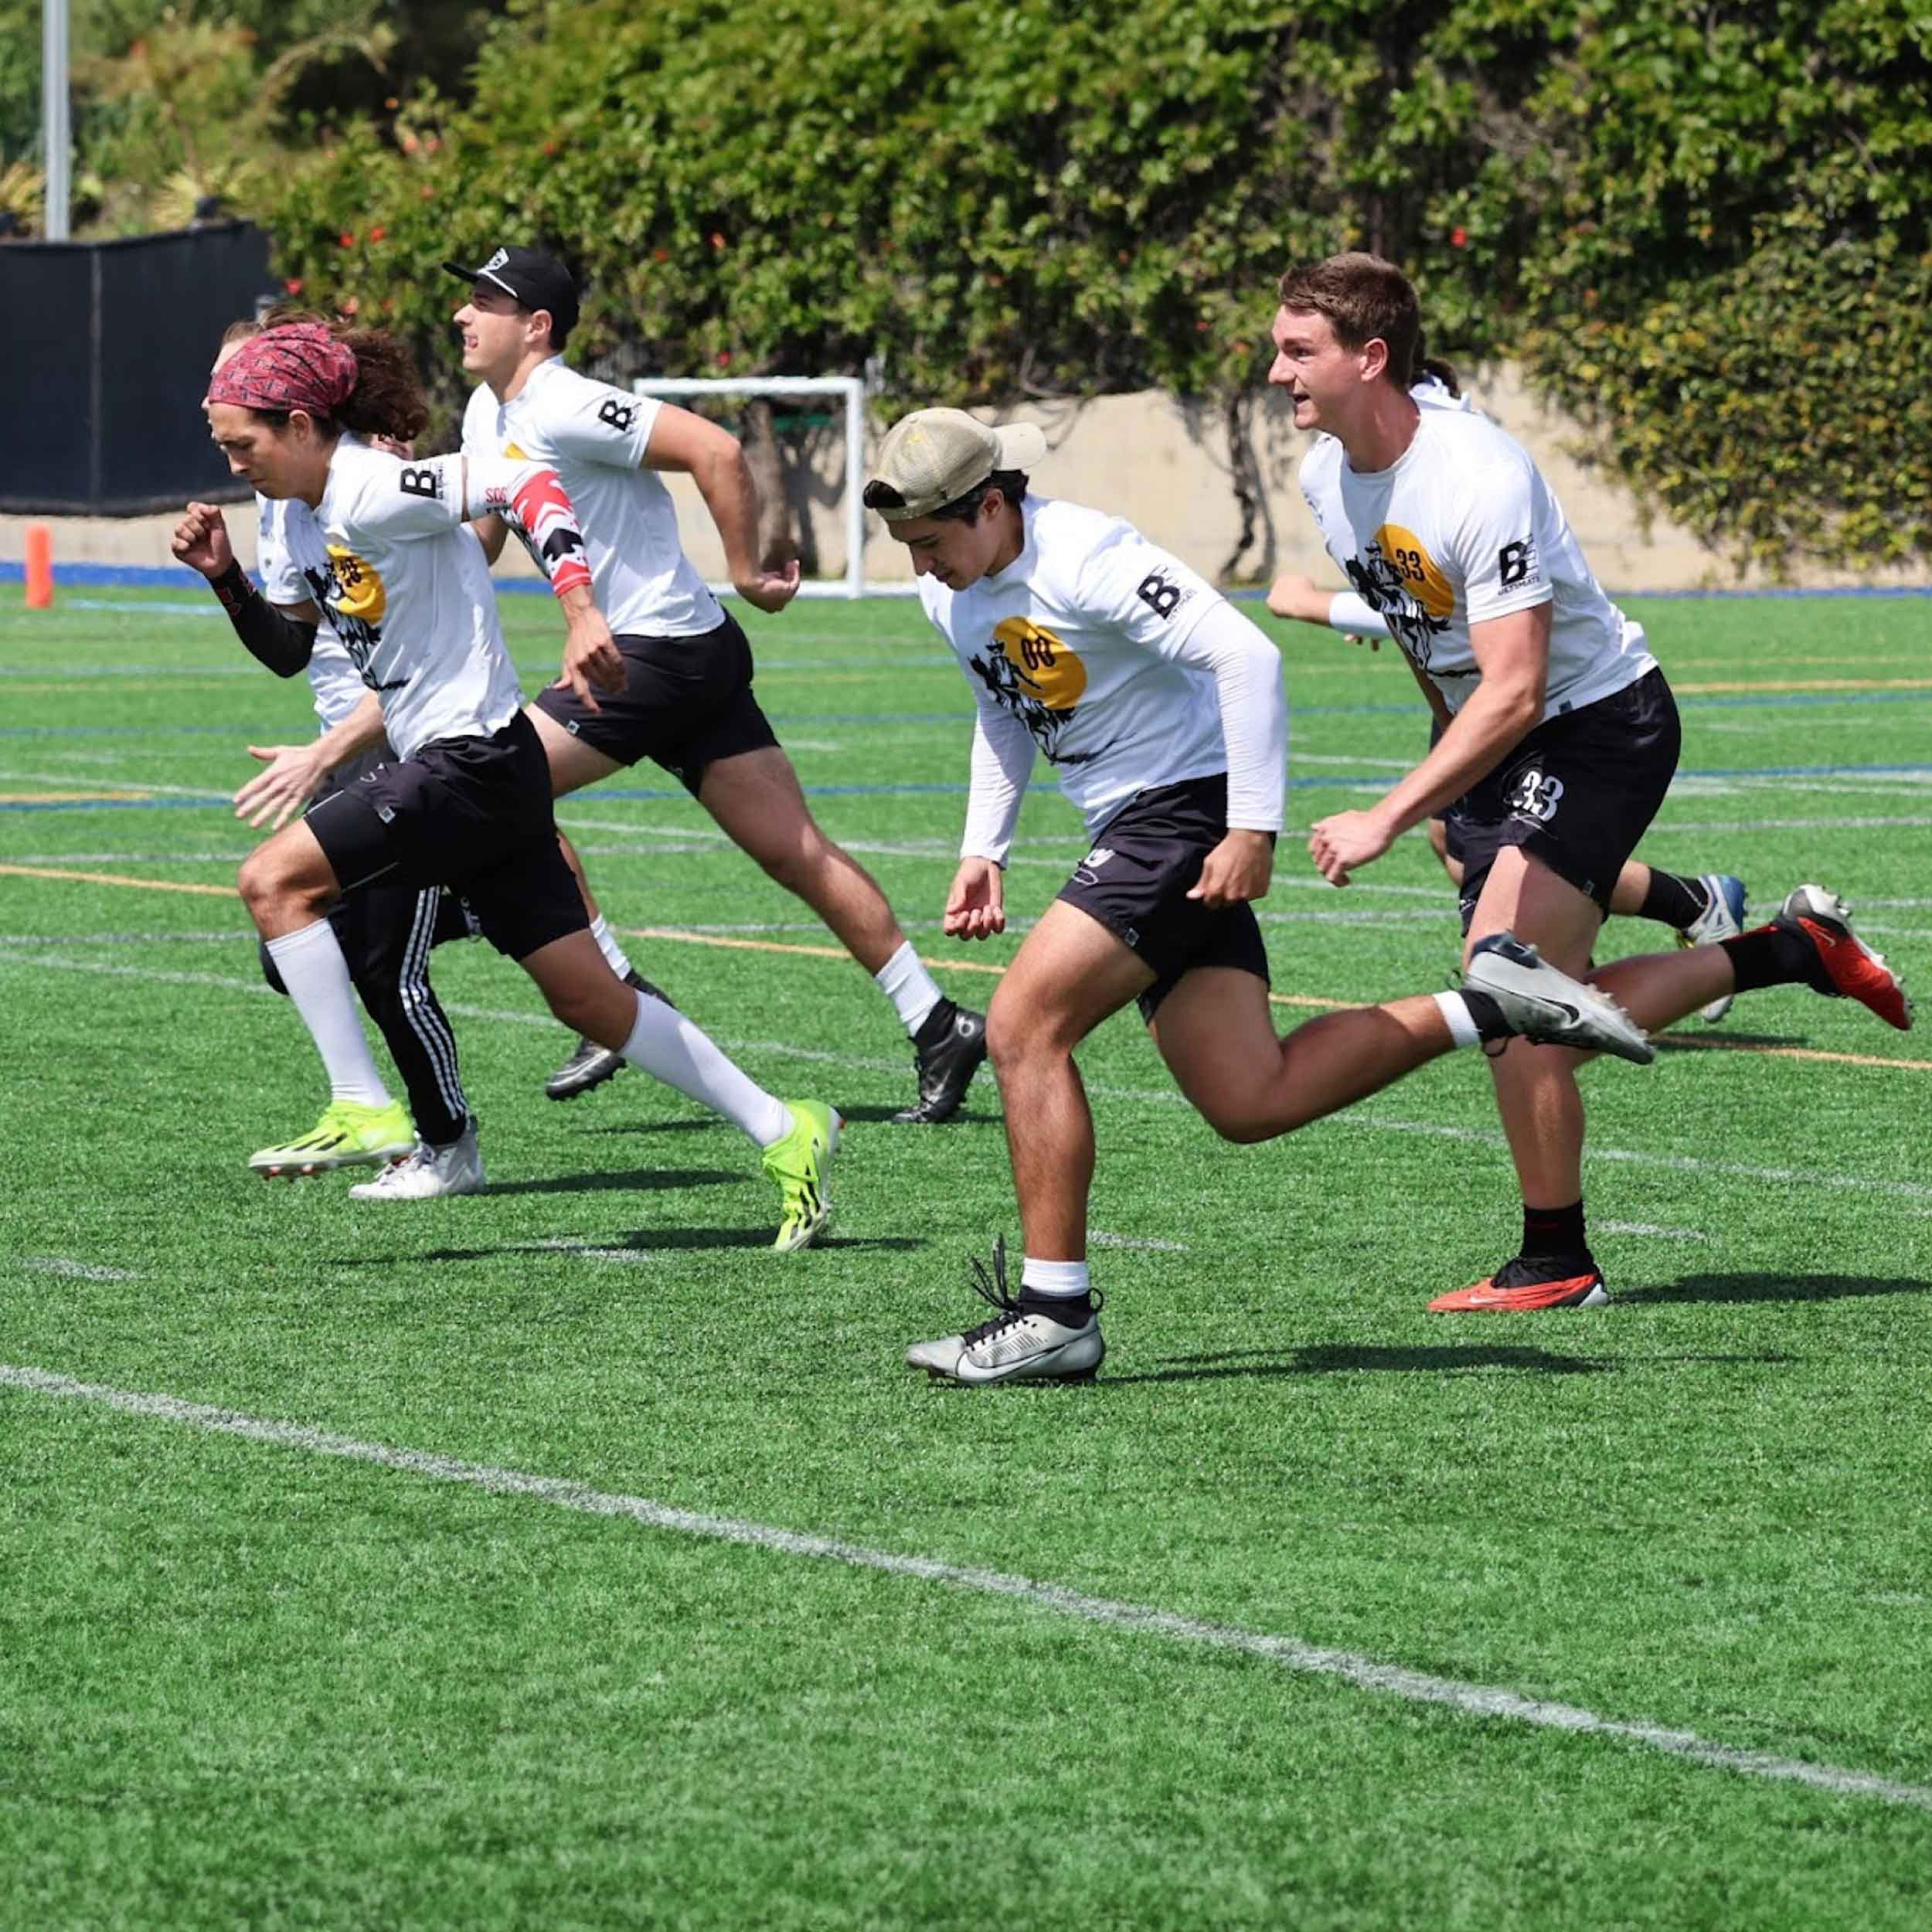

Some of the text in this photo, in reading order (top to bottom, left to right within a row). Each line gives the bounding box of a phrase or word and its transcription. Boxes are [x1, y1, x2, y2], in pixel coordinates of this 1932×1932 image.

[400, 468, 436, 498] B
[1396, 549, 1425, 581] 33
[1499, 541, 1528, 586] B
[1137, 575, 1180, 620] B
[1021, 634, 1056, 670] 00
[1513, 770, 1564, 821] 33
